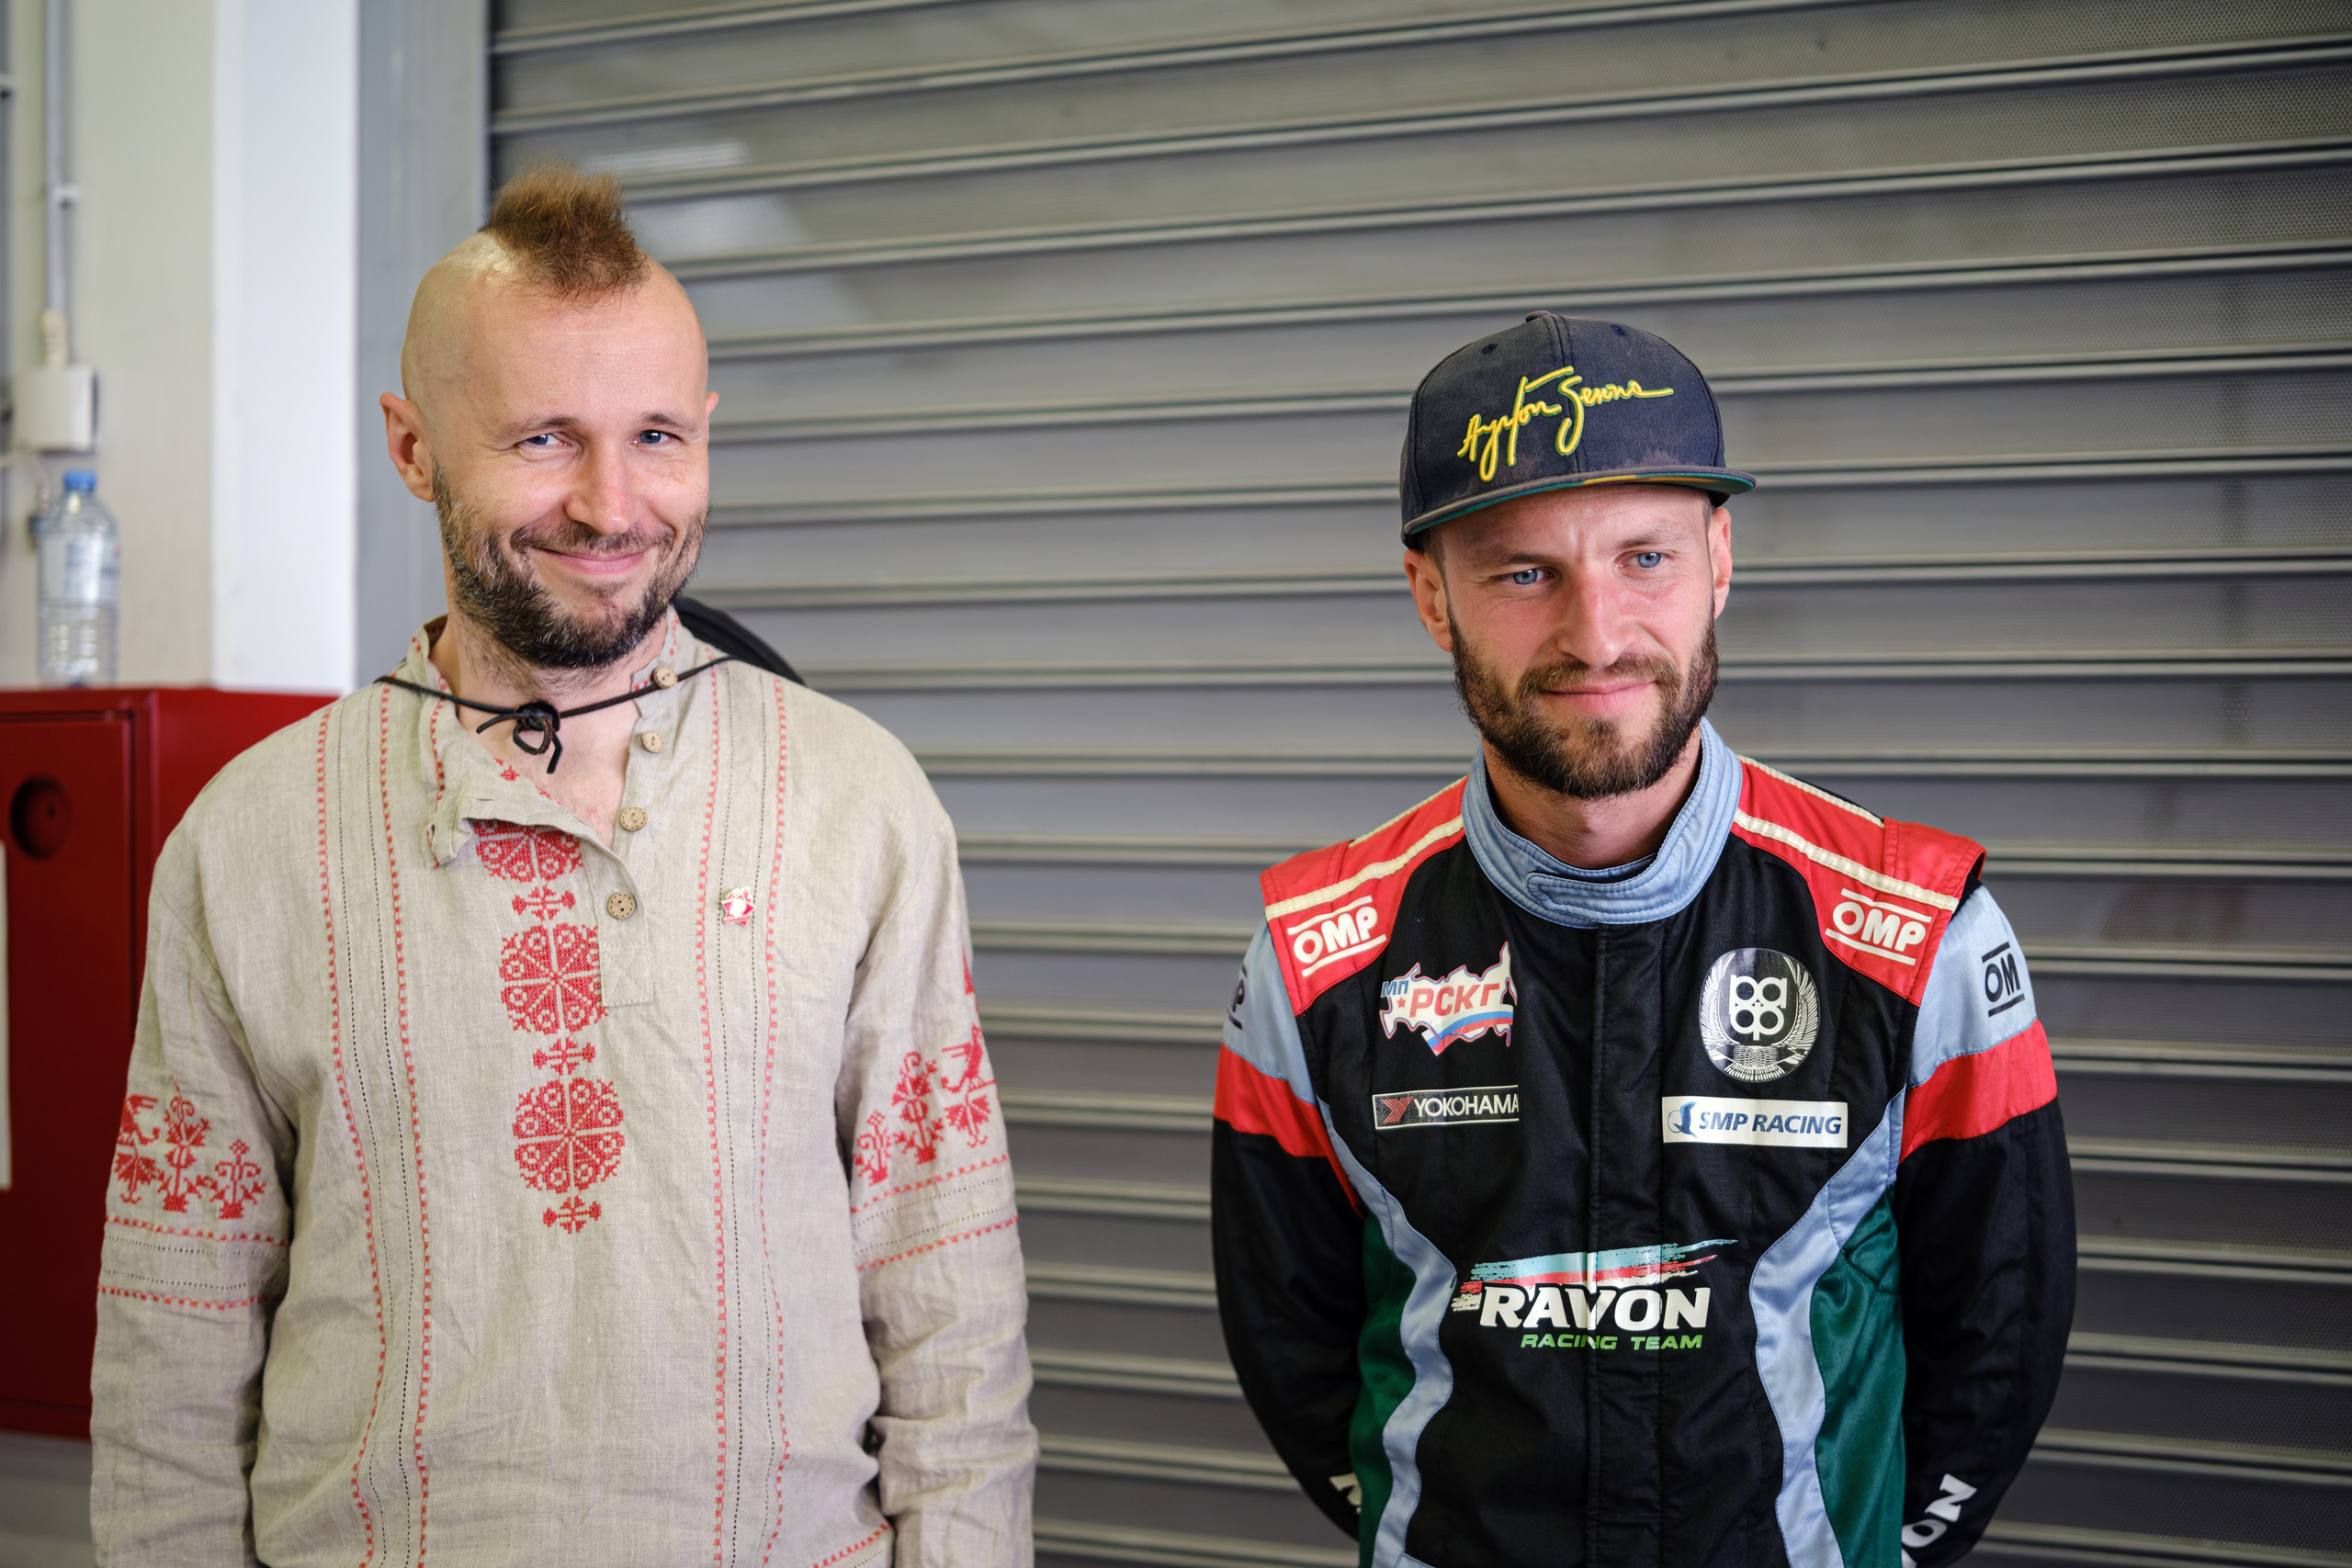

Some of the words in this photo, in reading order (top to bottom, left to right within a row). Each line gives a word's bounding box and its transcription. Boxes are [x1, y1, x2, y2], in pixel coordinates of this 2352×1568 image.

[1294, 906, 1378, 964] OMP
[1833, 901, 1927, 953] OMP
[1381, 979, 1409, 997] МП
[1408, 982, 1500, 1018] РСКГ
[1413, 1093, 1520, 1117] YOKOHAMA
[1700, 1111, 1748, 1131] SMP
[1751, 1113, 1842, 1135] RACING
[1479, 1286, 1711, 1331] RAVON
[1520, 1334, 1618, 1349] RACING
[1630, 1334, 1703, 1350] TEAM
